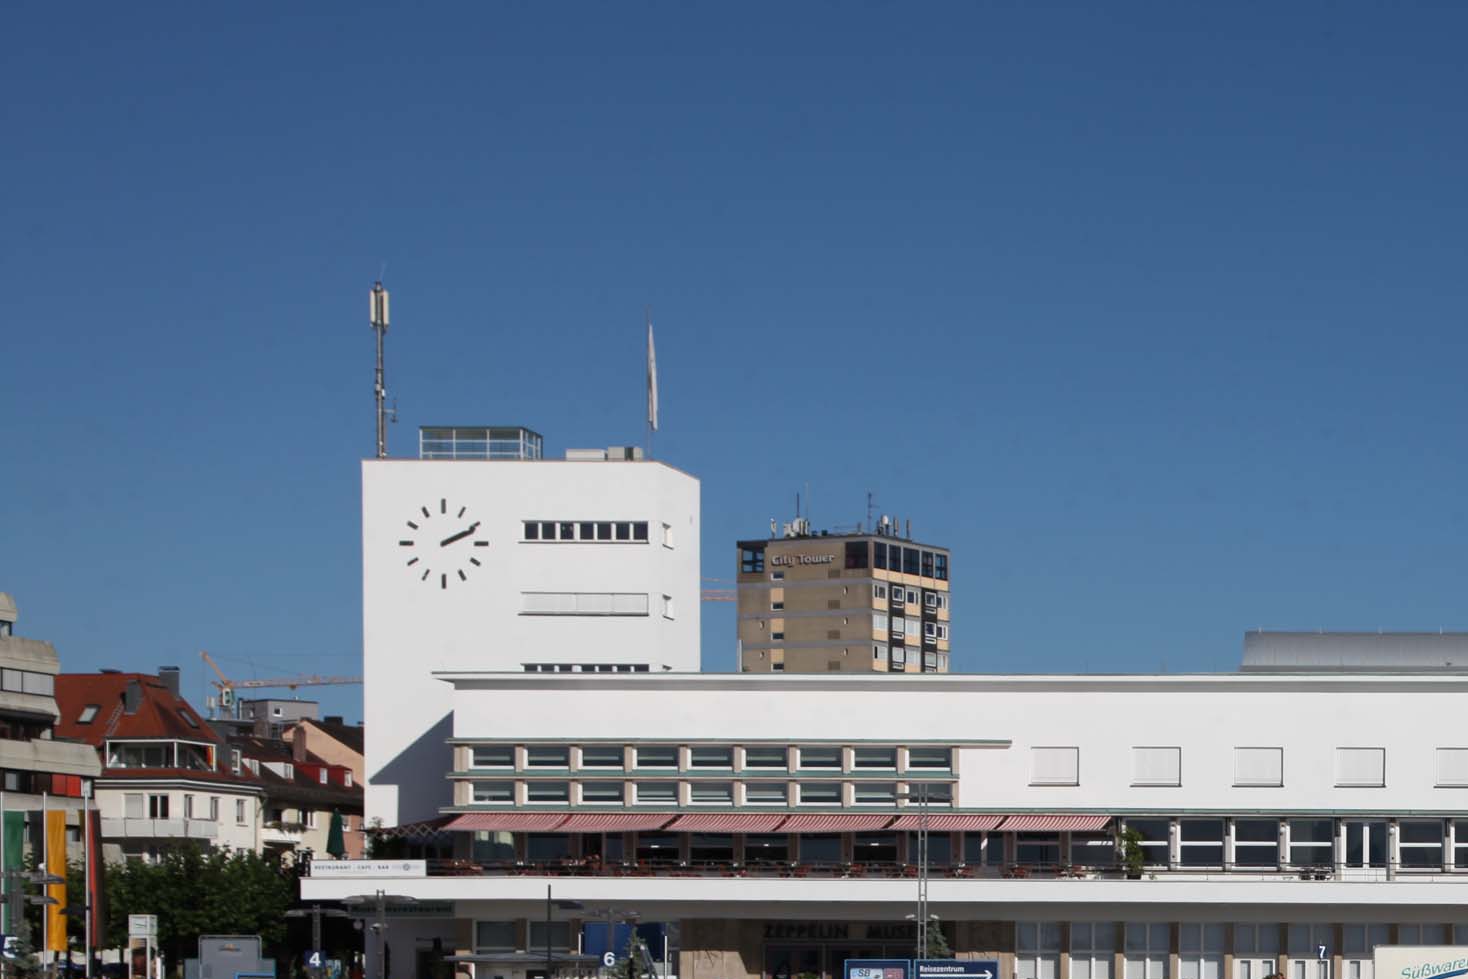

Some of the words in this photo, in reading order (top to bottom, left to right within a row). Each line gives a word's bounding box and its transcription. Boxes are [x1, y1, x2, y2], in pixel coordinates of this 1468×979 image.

[772, 555, 796, 568] City
[799, 554, 836, 565] Tower
[763, 923, 849, 939] ZEPPELIN
[309, 951, 321, 966] 4
[604, 951, 615, 966] 6
[1319, 945, 1326, 958] 7
[919, 965, 965, 973] Reisezentrum
